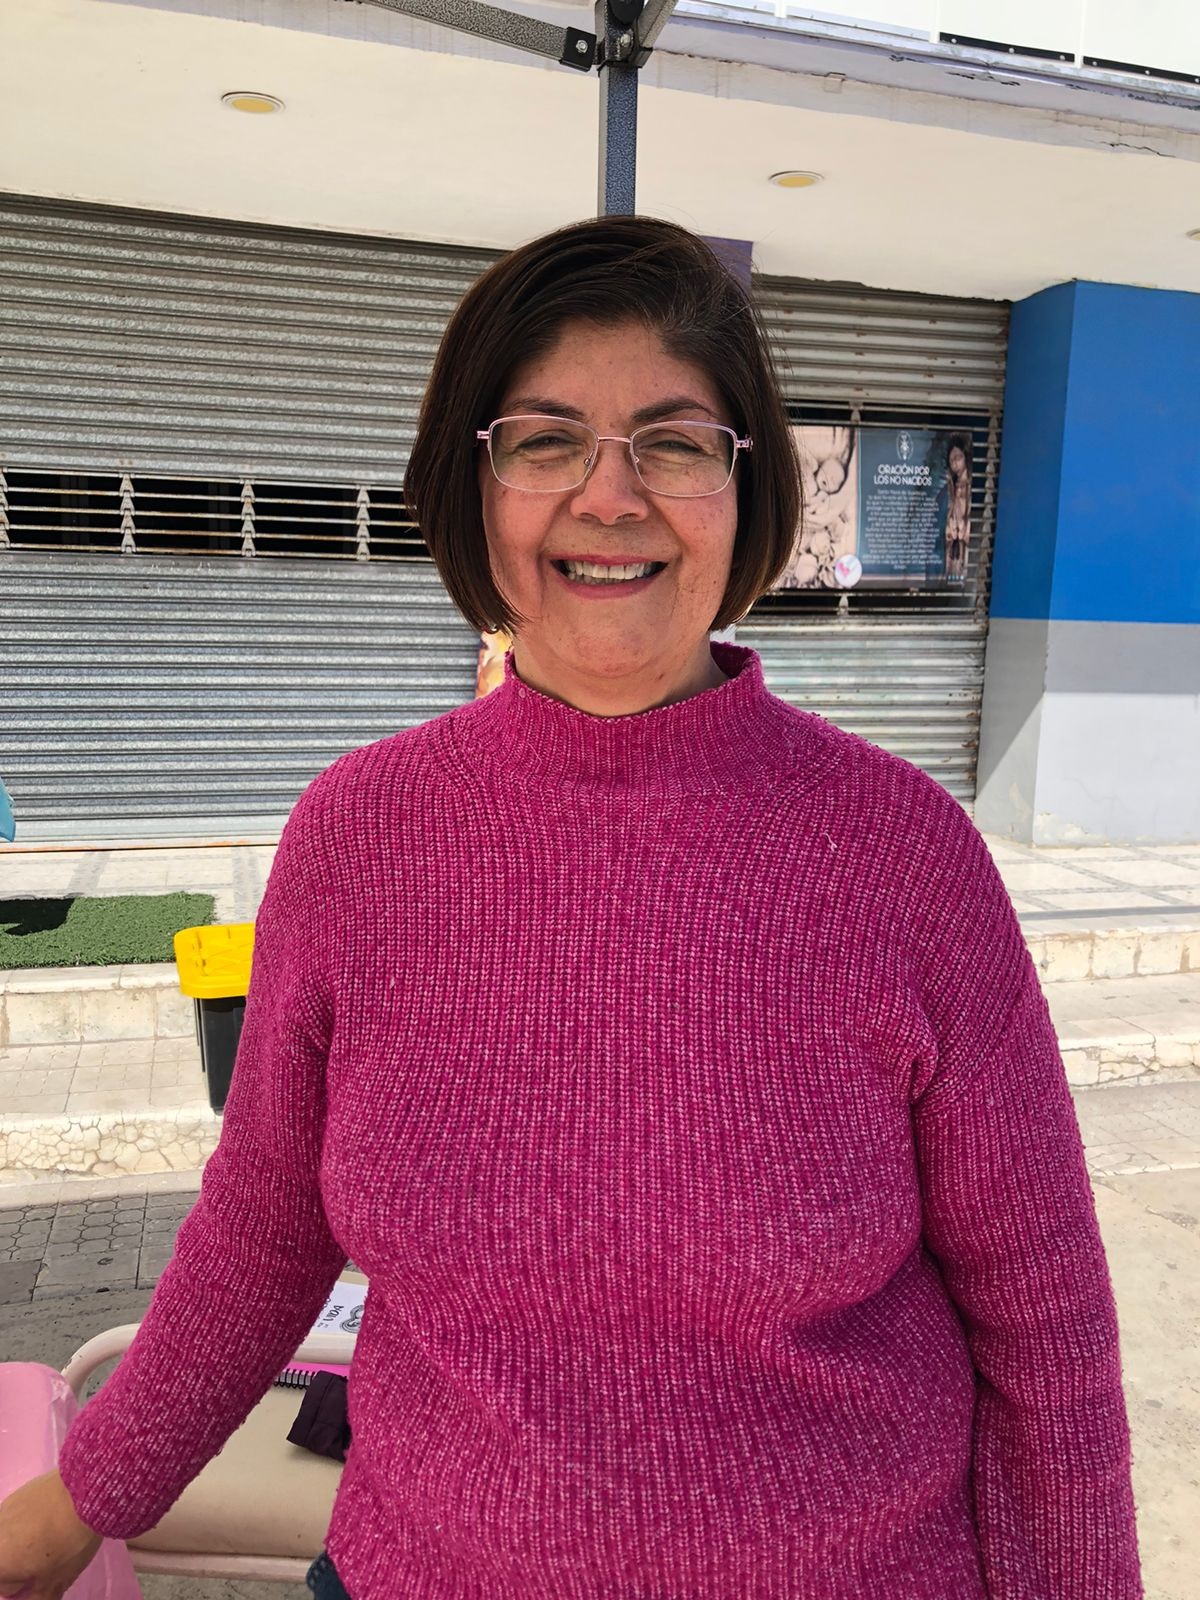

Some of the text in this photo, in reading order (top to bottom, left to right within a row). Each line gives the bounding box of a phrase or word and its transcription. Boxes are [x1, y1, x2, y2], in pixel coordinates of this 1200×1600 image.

[878, 464, 930, 475] ORACIÓN POR
[874, 475, 932, 486] LOS NO NACIDOS
